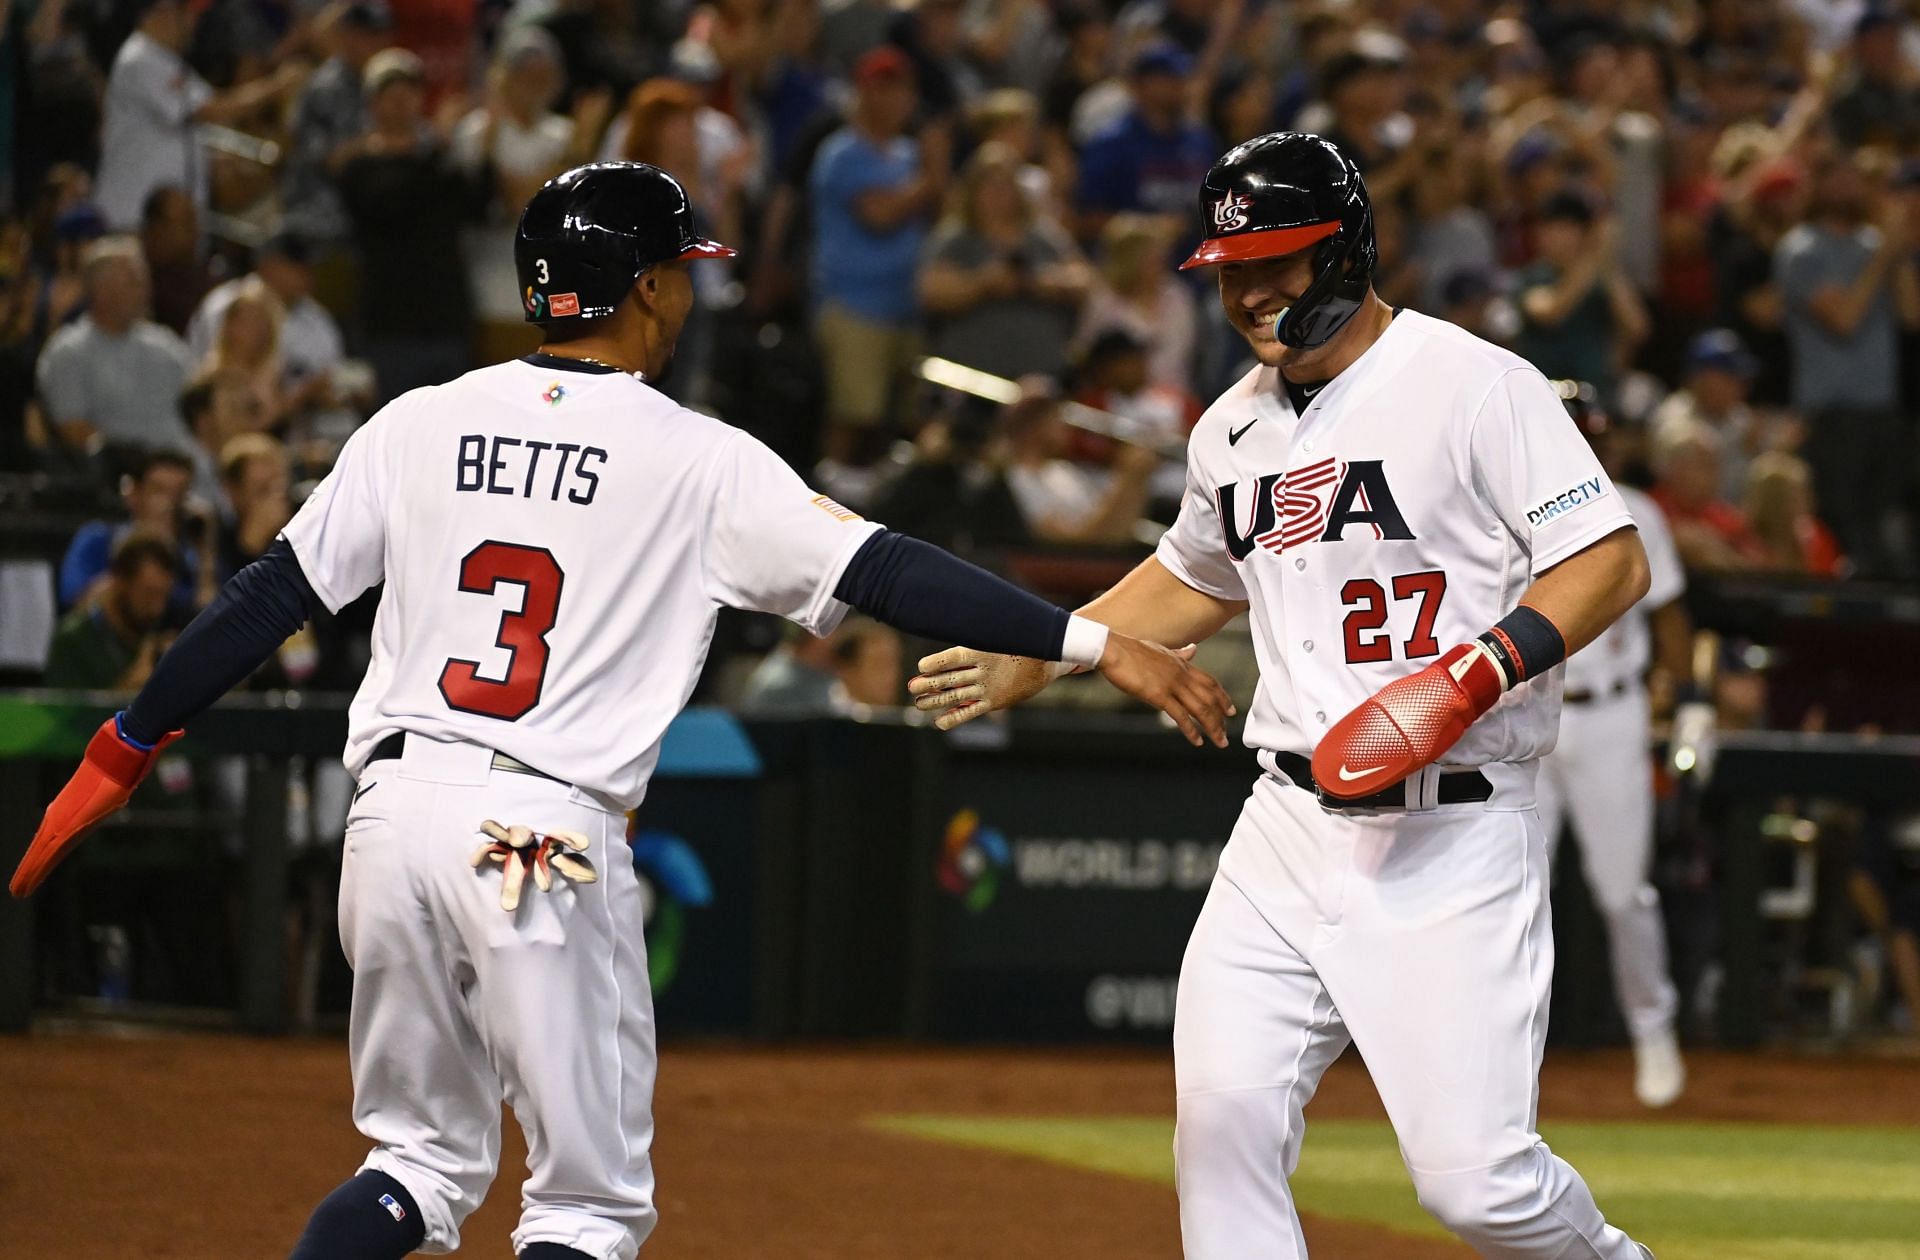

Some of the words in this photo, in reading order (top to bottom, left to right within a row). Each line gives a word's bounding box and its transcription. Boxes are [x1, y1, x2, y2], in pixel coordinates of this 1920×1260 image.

[536, 259, 549, 284] 3
[456, 434, 608, 506] BETTS
[1526, 477, 1601, 526] DIRECTV
[1215, 457, 1417, 562] USA
[437, 539, 565, 723] 3
[1340, 571, 1447, 664] 27
[1016, 839, 1168, 888] WORLD
